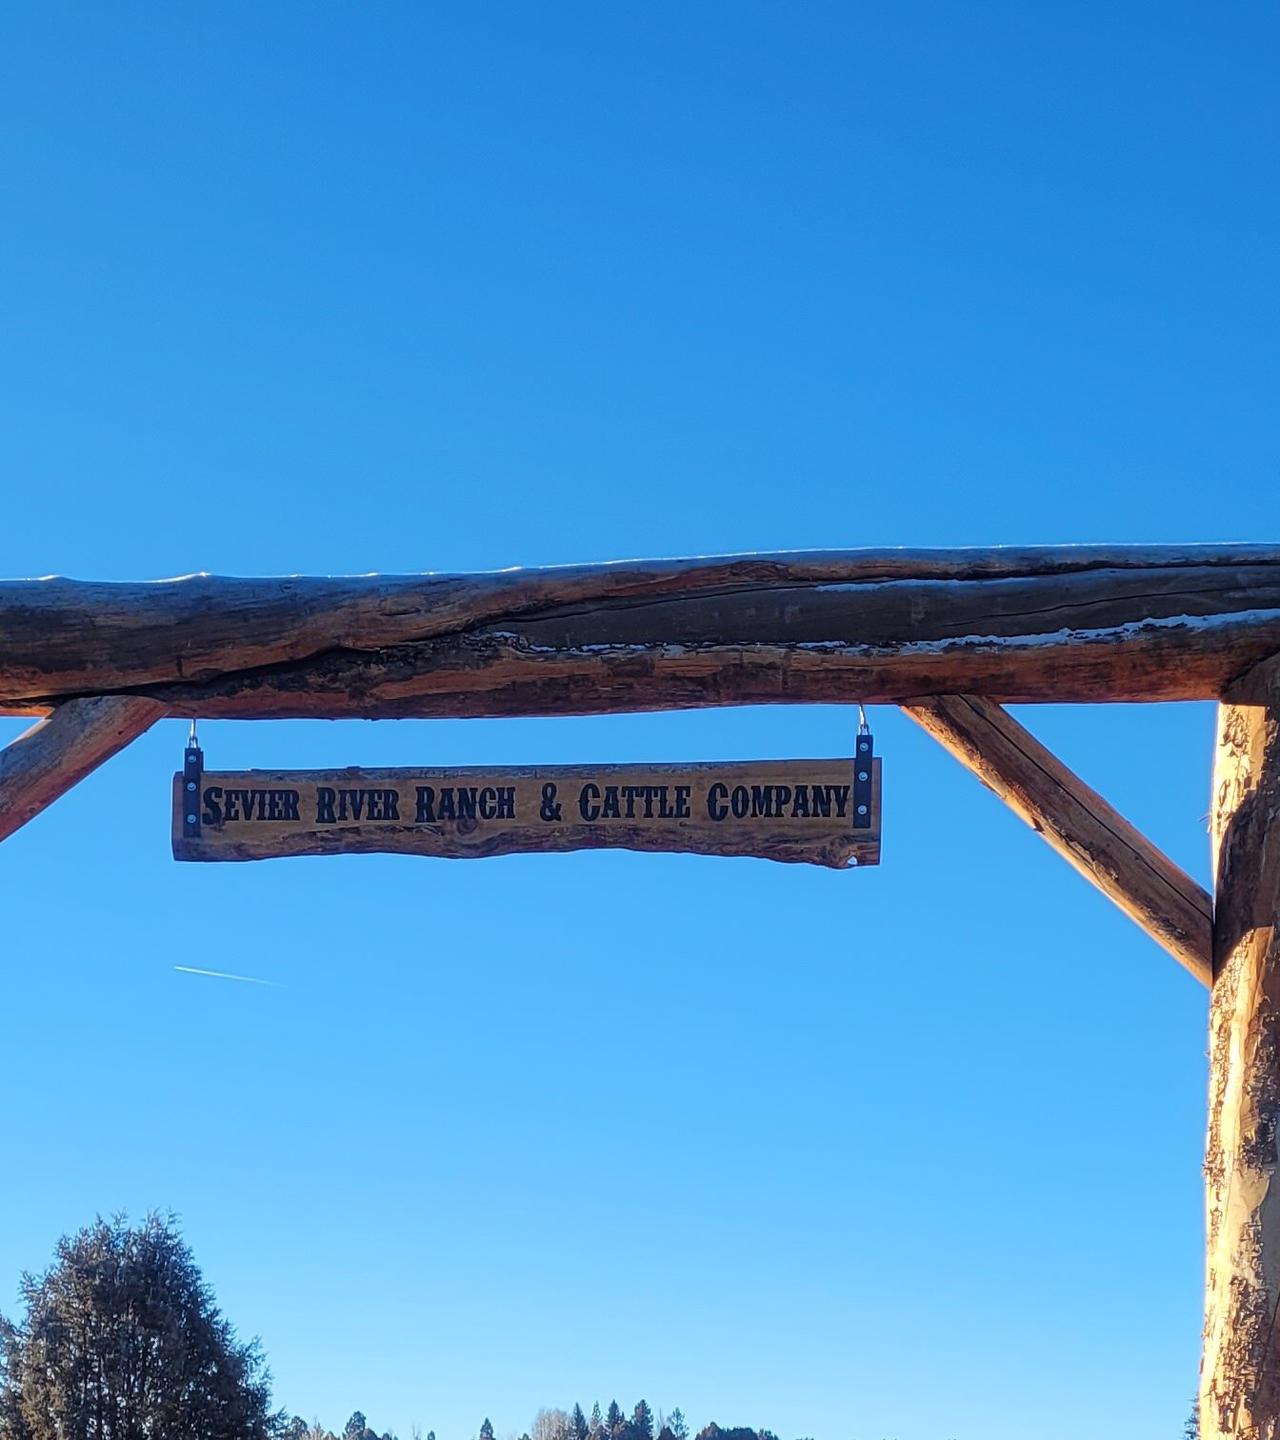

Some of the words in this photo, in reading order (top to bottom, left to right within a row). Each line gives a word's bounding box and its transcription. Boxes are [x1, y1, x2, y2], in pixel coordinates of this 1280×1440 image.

[202, 786, 301, 824] SEVIER
[316, 787, 400, 823] RIVER
[415, 786, 516, 822] RANCH
[539, 782, 562, 822] &
[578, 783, 691, 821] CATTLE
[707, 783, 850, 821] COMPANY
